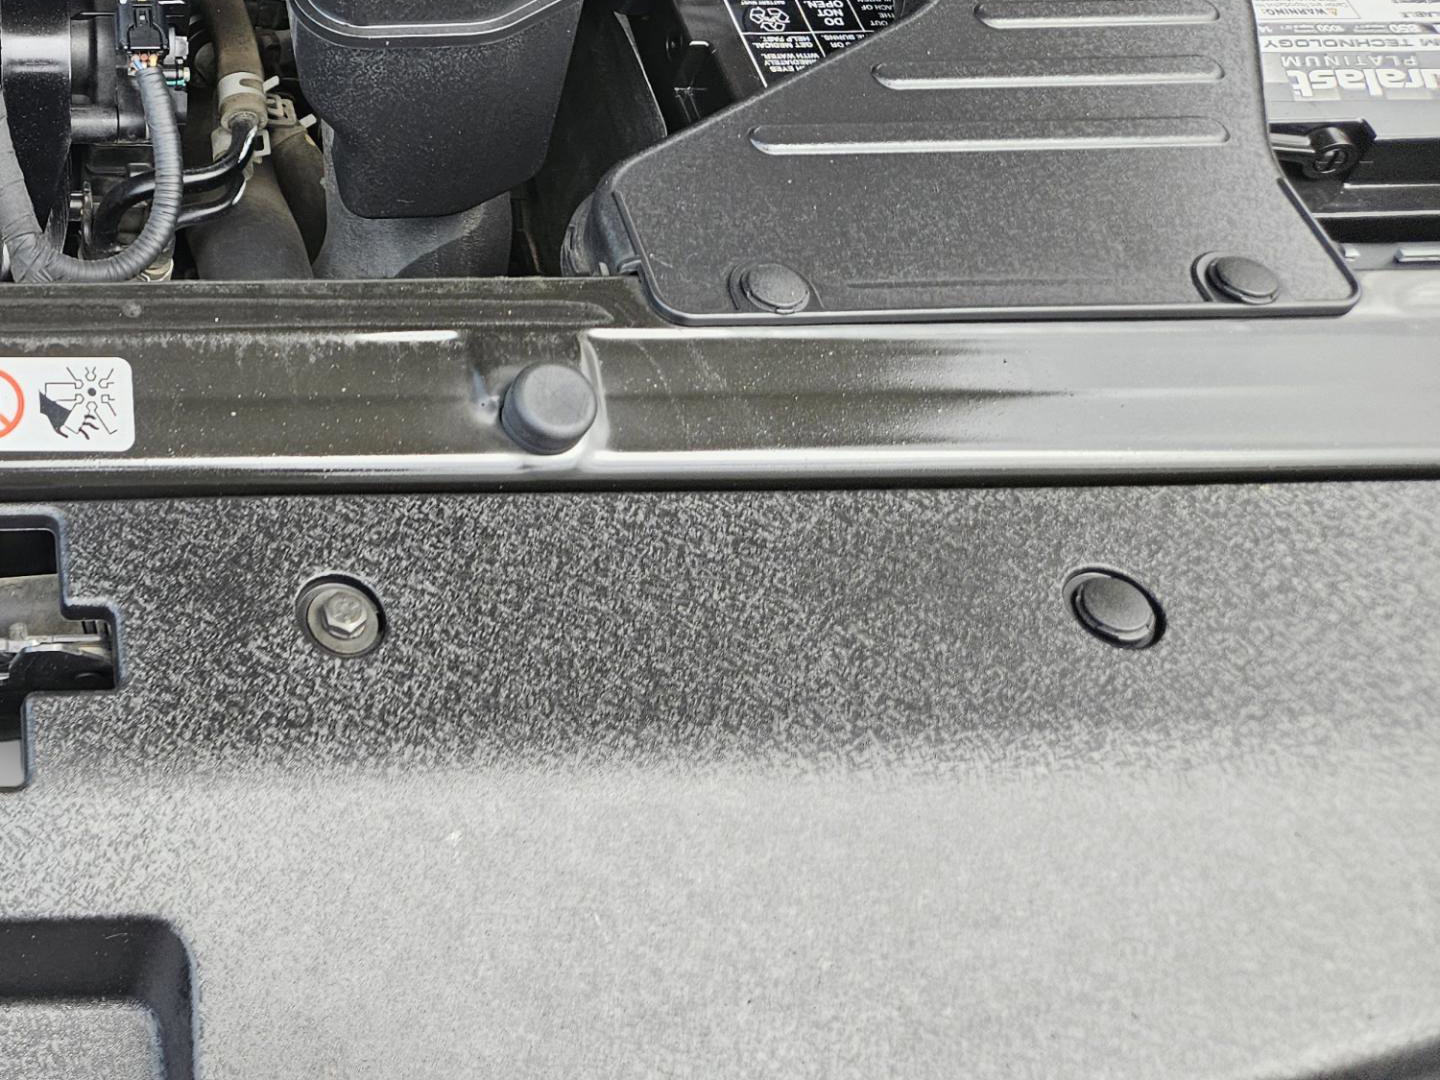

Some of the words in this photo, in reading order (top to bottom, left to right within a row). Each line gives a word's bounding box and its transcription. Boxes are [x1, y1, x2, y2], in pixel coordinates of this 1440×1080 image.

[803, 0, 844, 9] OPEN.
[817, 9, 844, 17] NOT
[1262, 7, 1328, 17] WARNING:
[823, 18, 845, 26] DO
[1264, 38, 1414, 49] TECHNOLOGY
[1281, 55, 1418, 67] PLATINUM
[1287, 69, 1440, 97] uralast
